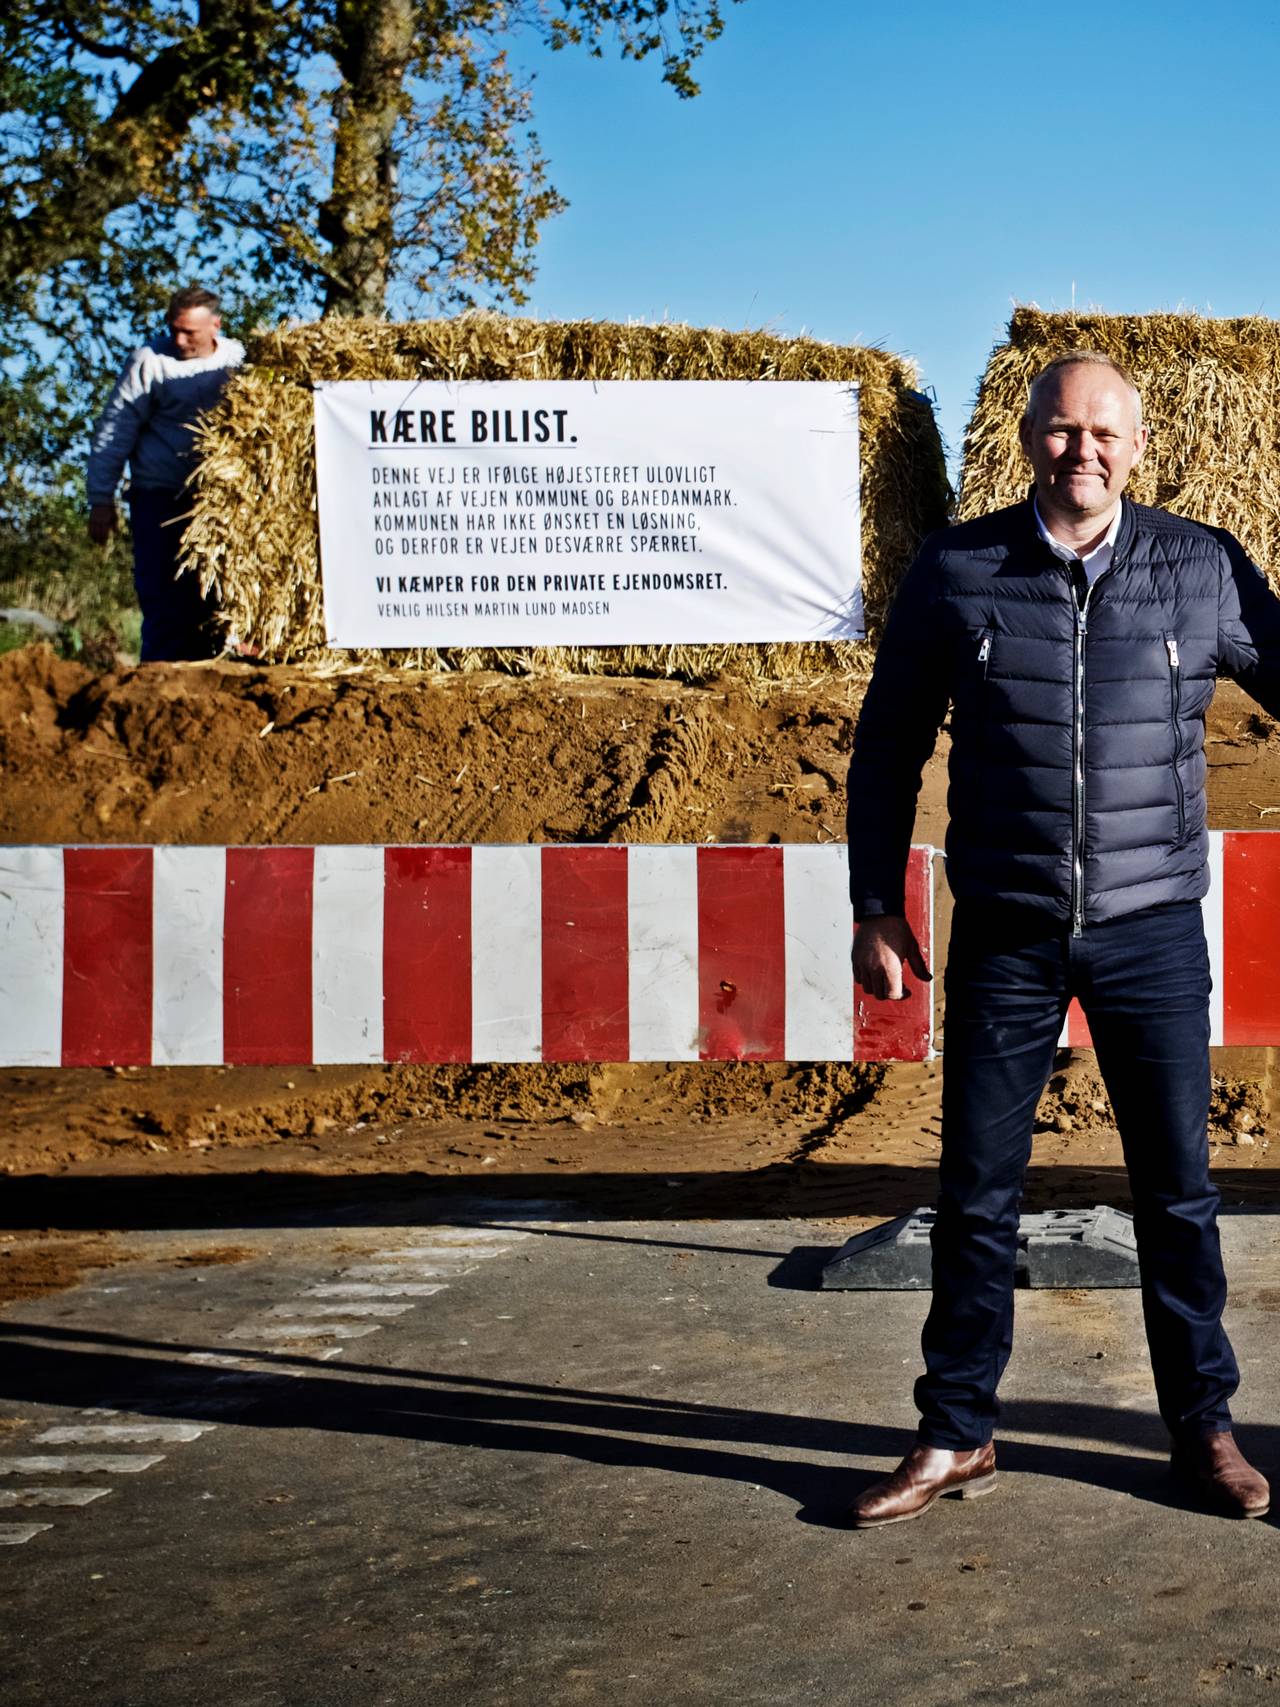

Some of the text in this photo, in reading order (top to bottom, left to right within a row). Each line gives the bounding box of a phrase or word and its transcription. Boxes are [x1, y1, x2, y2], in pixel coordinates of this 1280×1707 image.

[370, 409, 578, 443] KÆRE BILIST.
[372, 465, 717, 485] DENNE VEJ ER IFØLGE HØJESTERET ULOVLIGT
[373, 488, 737, 508] ANLAGT AF VEJEN KOMMUNE OG BANEDANMARK.
[374, 513, 458, 532] KOMMUNEN
[467, 513, 495, 531] HAR
[503, 513, 536, 531] IKKE
[543, 512, 600, 531] ØNSKET
[607, 512, 625, 530] EN
[375, 534, 702, 555] OG DERFOR ER VEJEN DESVÆRRE SPÆRRET.
[376, 573, 727, 593] VI KÆMPER FOR DEN PRIVATE EJENDOMSRET.
[378, 601, 609, 617] VENLIG HILSEN MARTIN LUND MADSEN
